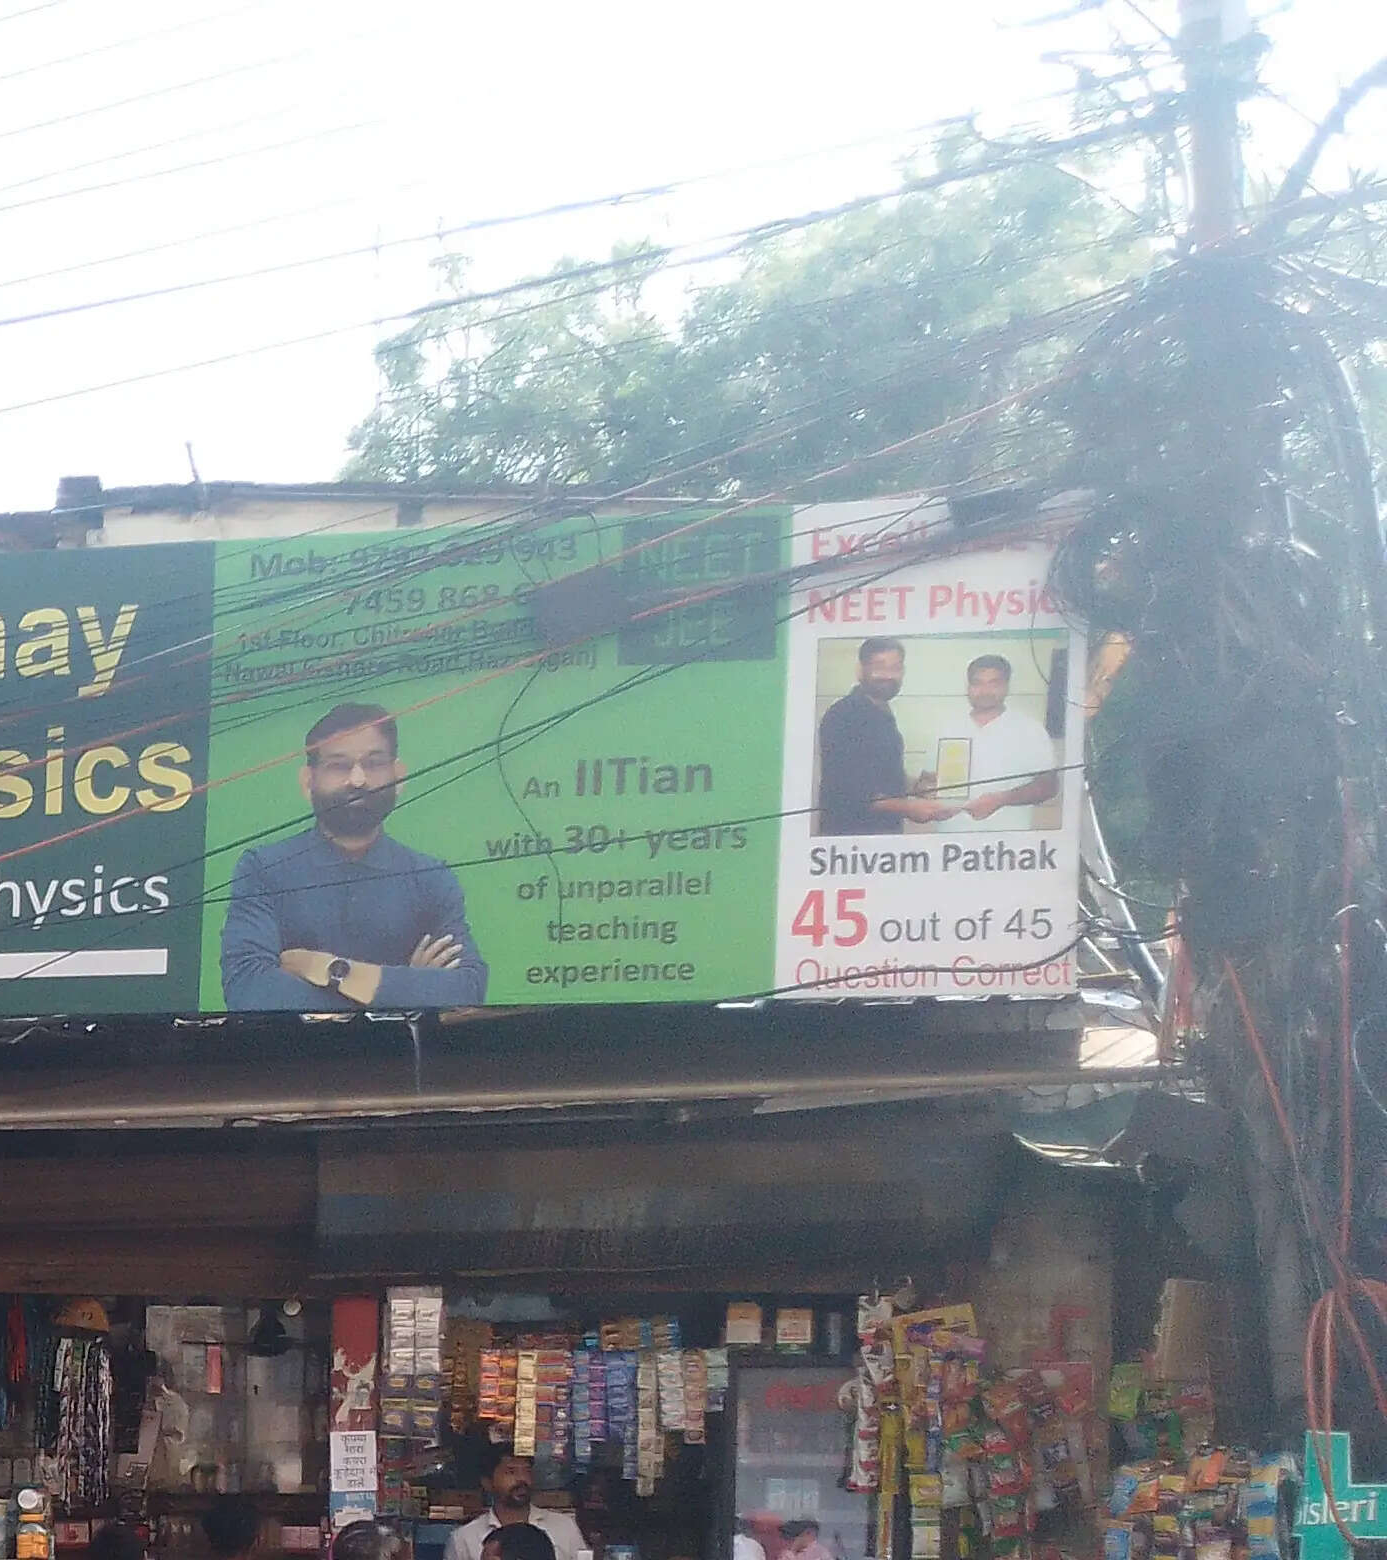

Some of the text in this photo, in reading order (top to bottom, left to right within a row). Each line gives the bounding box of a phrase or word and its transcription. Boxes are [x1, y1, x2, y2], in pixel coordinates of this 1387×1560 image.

[807, 580, 1059, 625] NEET Physic
[523, 756, 713, 799] An IITian
[485, 820, 748, 859] with 30+ years
[810, 839, 1058, 876] Shivam Pathak
[517, 870, 713, 909] of unparallel
[546, 917, 678, 946] teaching
[790, 888, 1053, 948] 45 out of 45
[525, 957, 696, 988] experience
[795, 954, 1072, 992] Question Correct
